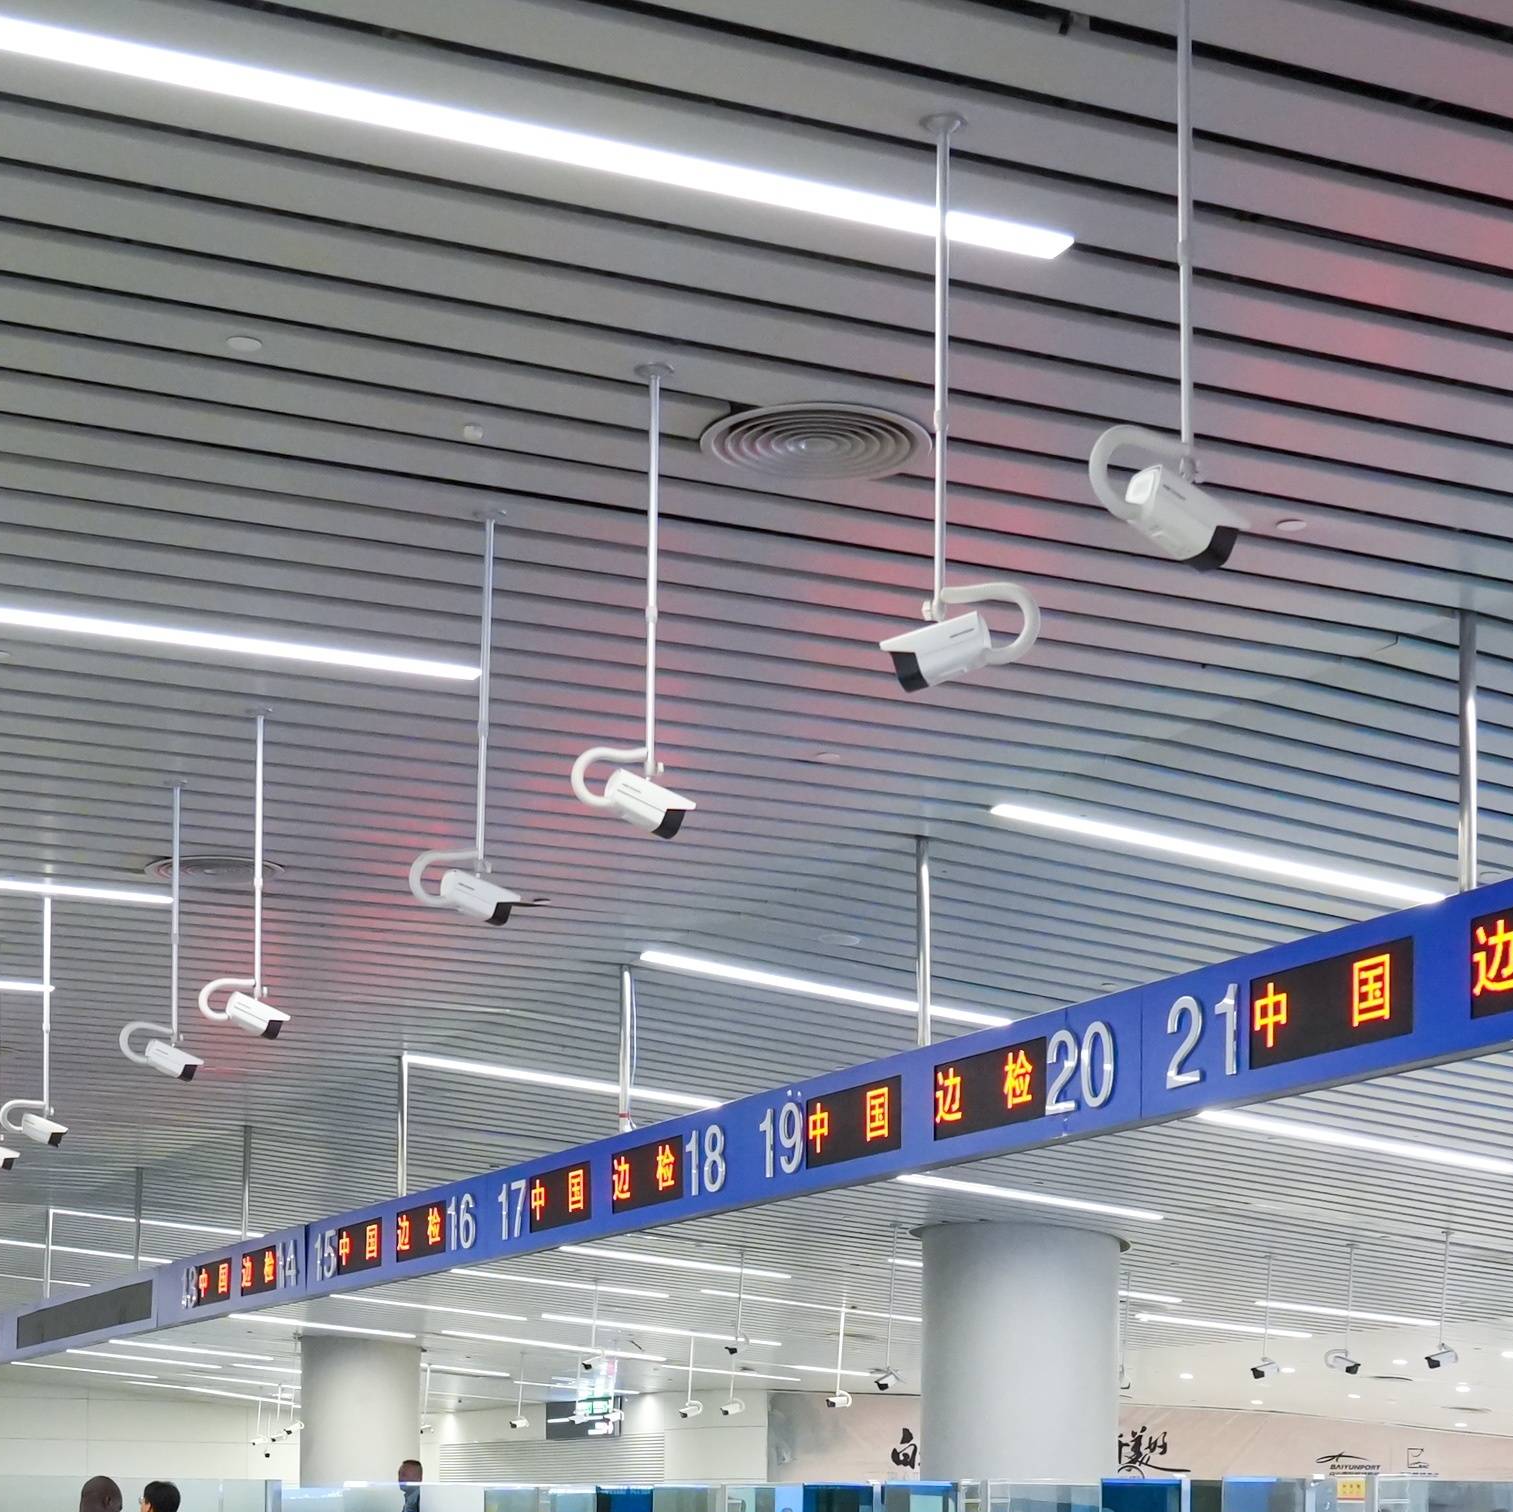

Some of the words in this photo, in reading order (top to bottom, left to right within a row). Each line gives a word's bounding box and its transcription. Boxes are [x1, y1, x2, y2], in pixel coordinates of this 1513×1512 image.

[1253, 953, 1392, 1049] 中国
[1166, 983, 1239, 1090] 21
[935, 1050, 1033, 1125] 边检
[1044, 1021, 1116, 1115] 20
[759, 1102, 804, 1179] 19
[808, 1086, 889, 1154] 中国
[612, 1143, 676, 1201] 边检
[685, 1124, 727, 1197] 18
[446, 1192, 477, 1251] 16
[497, 1178, 527, 1241] 17
[530, 1168, 585, 1221] 中国
[314, 1229, 338, 1281] 15
[338, 1223, 379, 1266] 中国
[396, 1207, 442, 1252] 边检
[198, 1261, 229, 1299] 中国
[241, 1250, 276, 1288] 边检
[276, 1239, 298, 1288] 14
